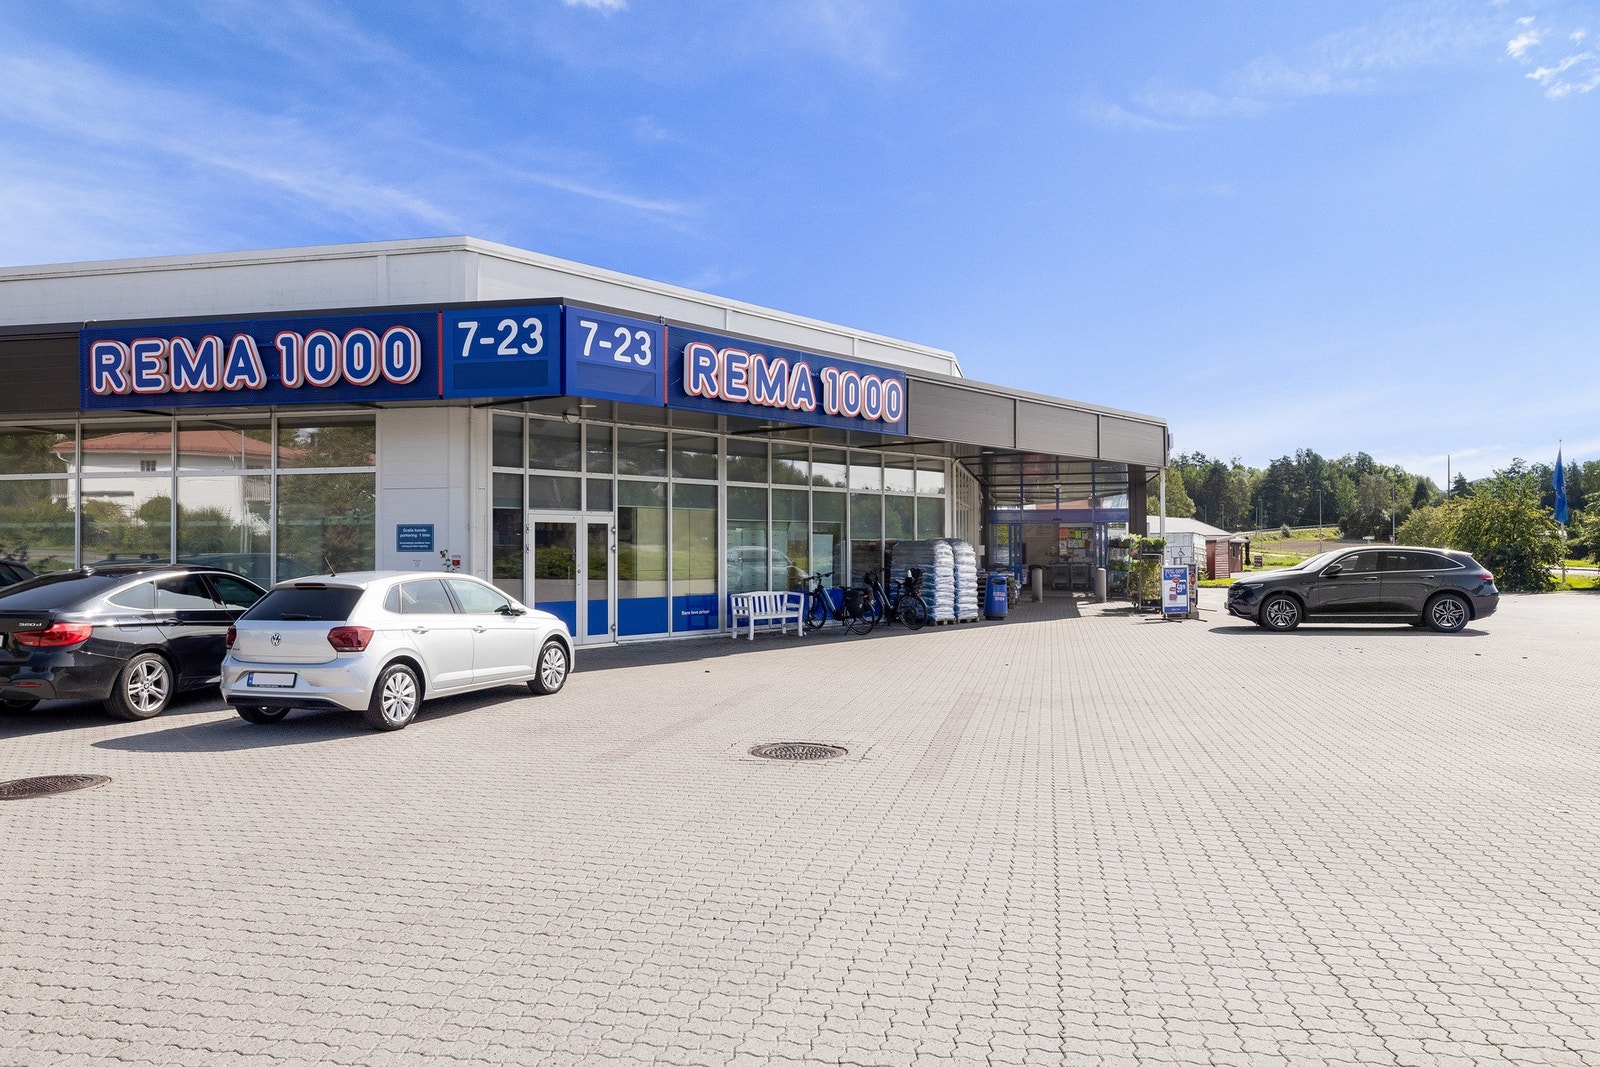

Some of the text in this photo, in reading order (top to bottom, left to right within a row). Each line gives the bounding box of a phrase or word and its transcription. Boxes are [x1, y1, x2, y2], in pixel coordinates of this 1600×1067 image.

[90, 325, 422, 395] REMA 1000
[458, 317, 544, 357] 7-23
[579, 320, 652, 366] 7-23
[684, 341, 905, 424] REMA 1000
